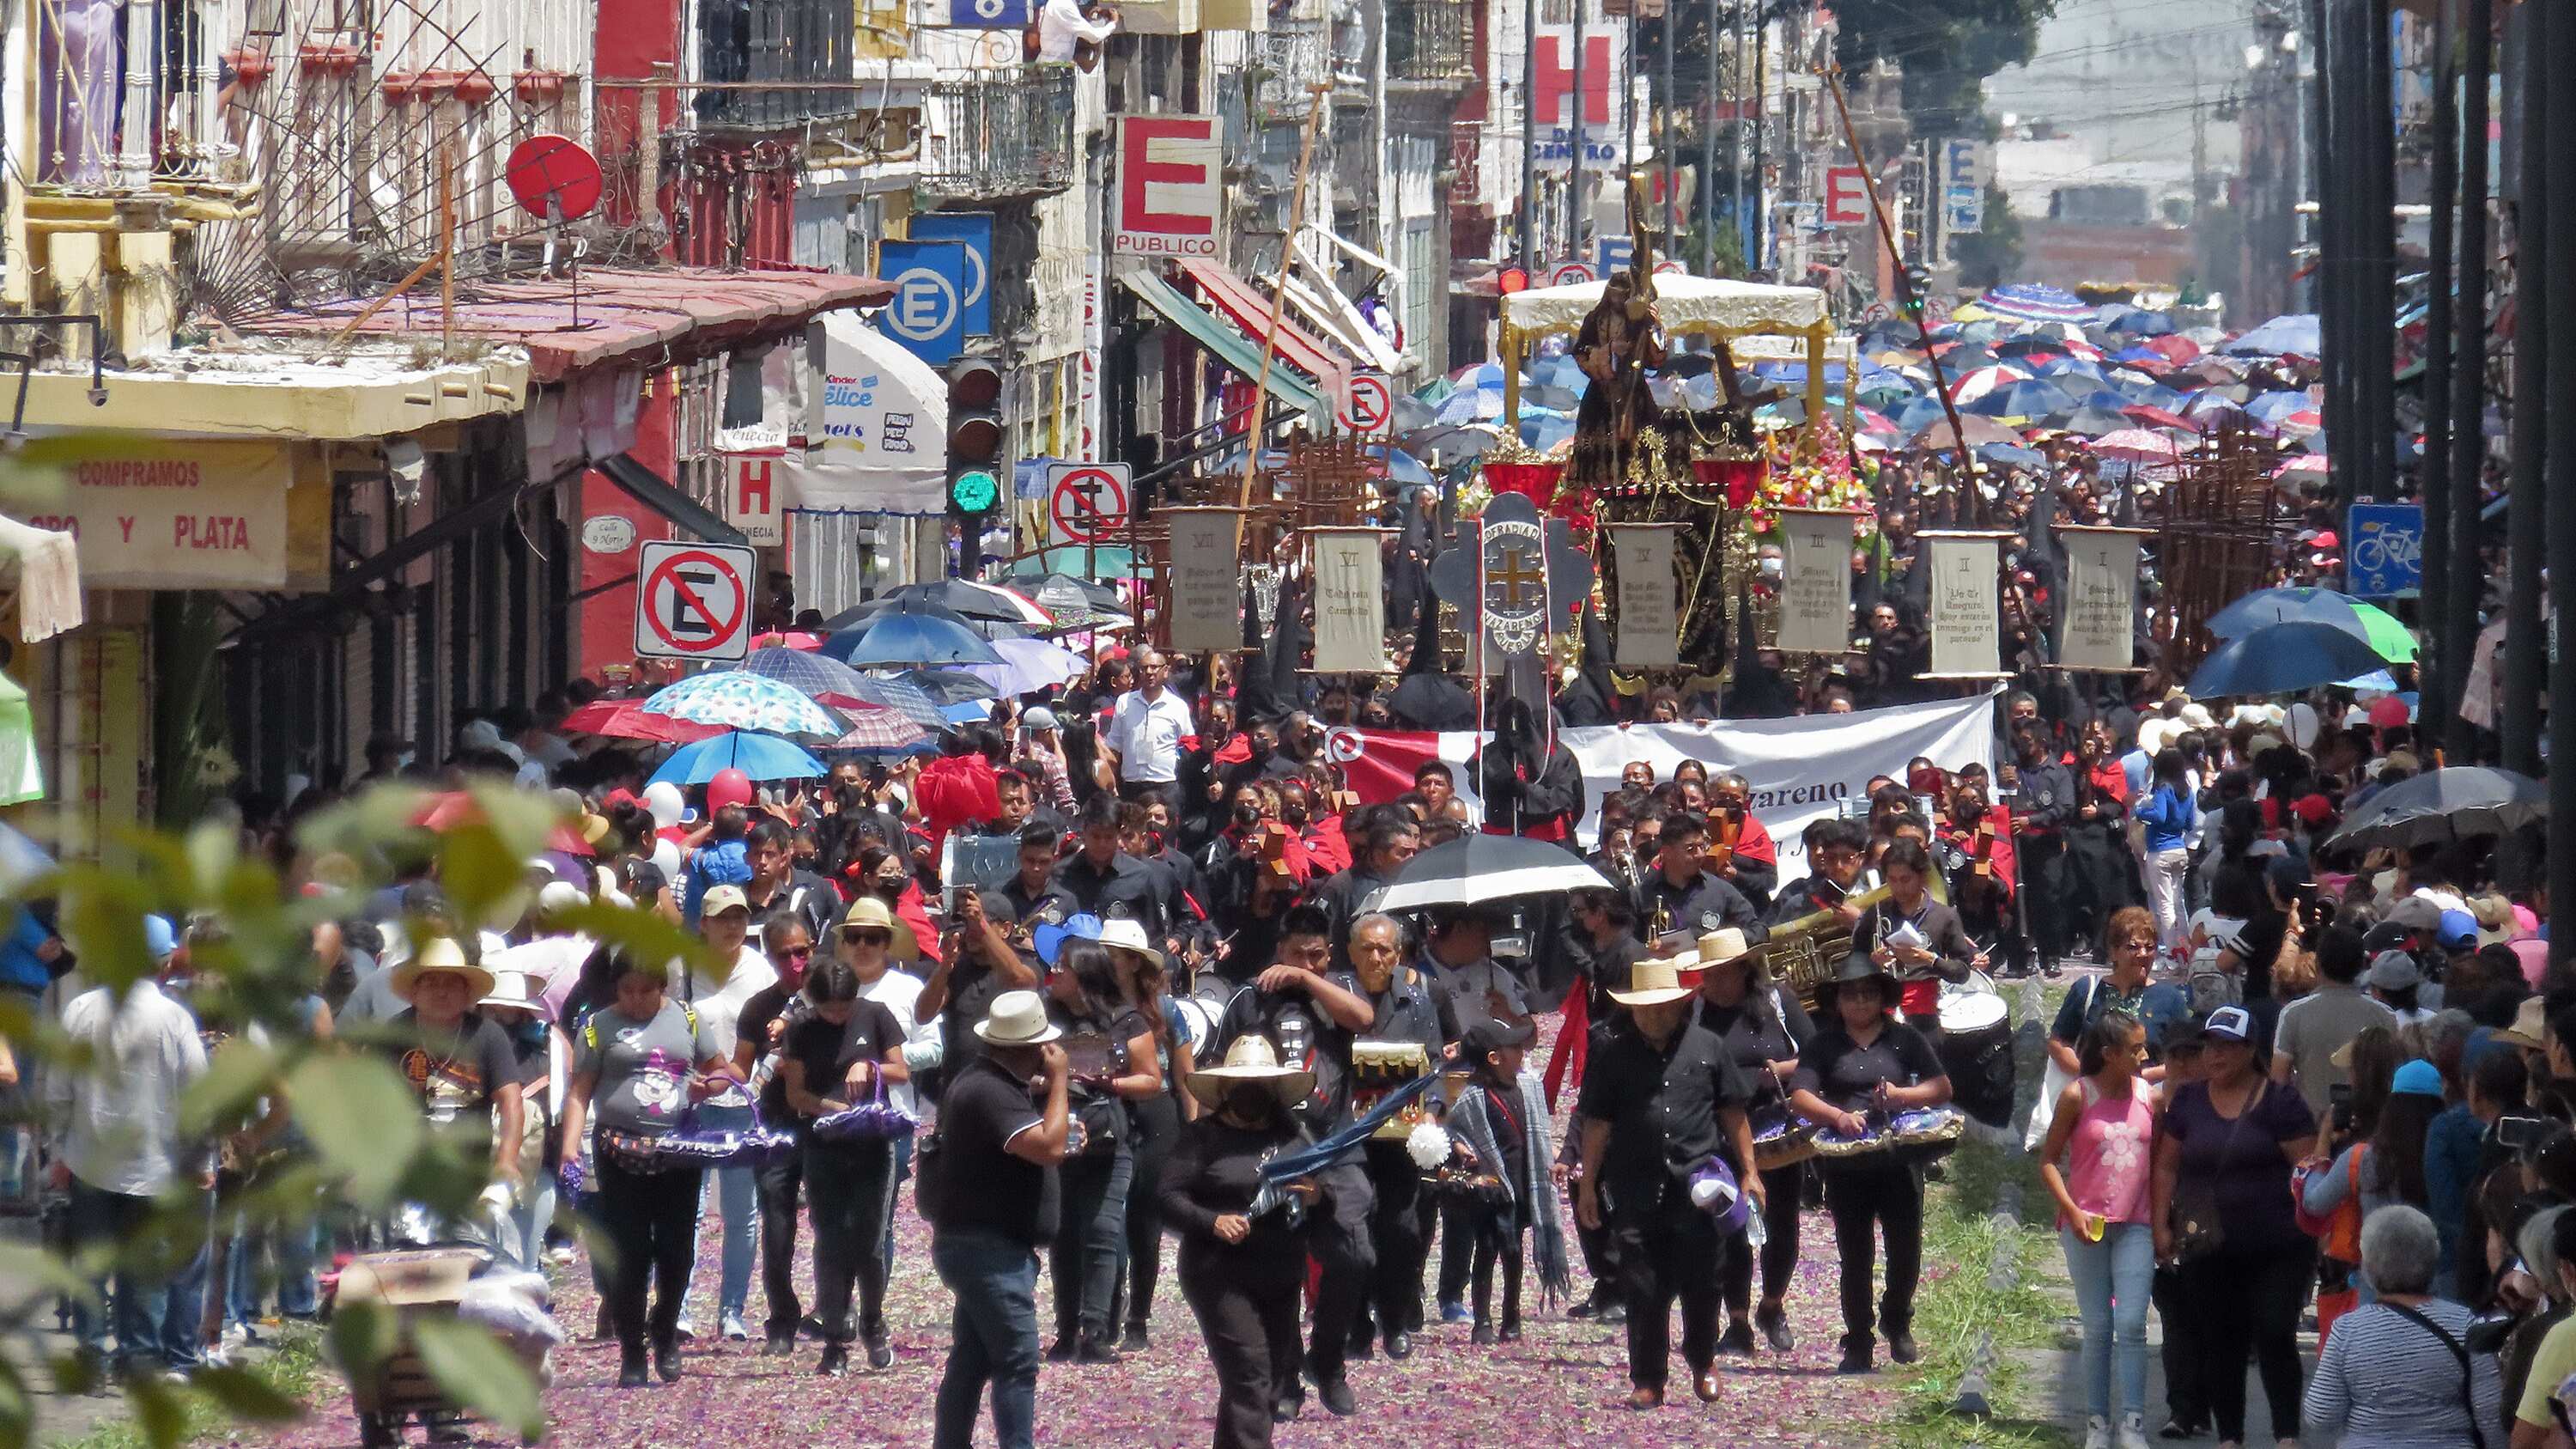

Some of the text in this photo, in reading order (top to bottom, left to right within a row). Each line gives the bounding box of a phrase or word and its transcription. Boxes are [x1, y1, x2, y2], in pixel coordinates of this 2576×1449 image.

[1535, 36, 1610, 124] H
[1122, 117, 1212, 234] E
[1826, 167, 1866, 222] E
[1116, 234, 1216, 254] PUBLICO
[903, 283, 939, 326] E
[824, 385, 872, 407] élice
[732, 429, 778, 442] enecia
[77, 460, 200, 487] COMPRAMOS
[739, 461, 771, 514] H
[118, 516, 134, 543] Y
[174, 515, 249, 550] PLATA
[1483, 524, 1528, 541] OFRADIA
[1340, 551, 1358, 566] VI
[672, 571, 716, 634] E
[1748, 781, 1847, 810] zareno
